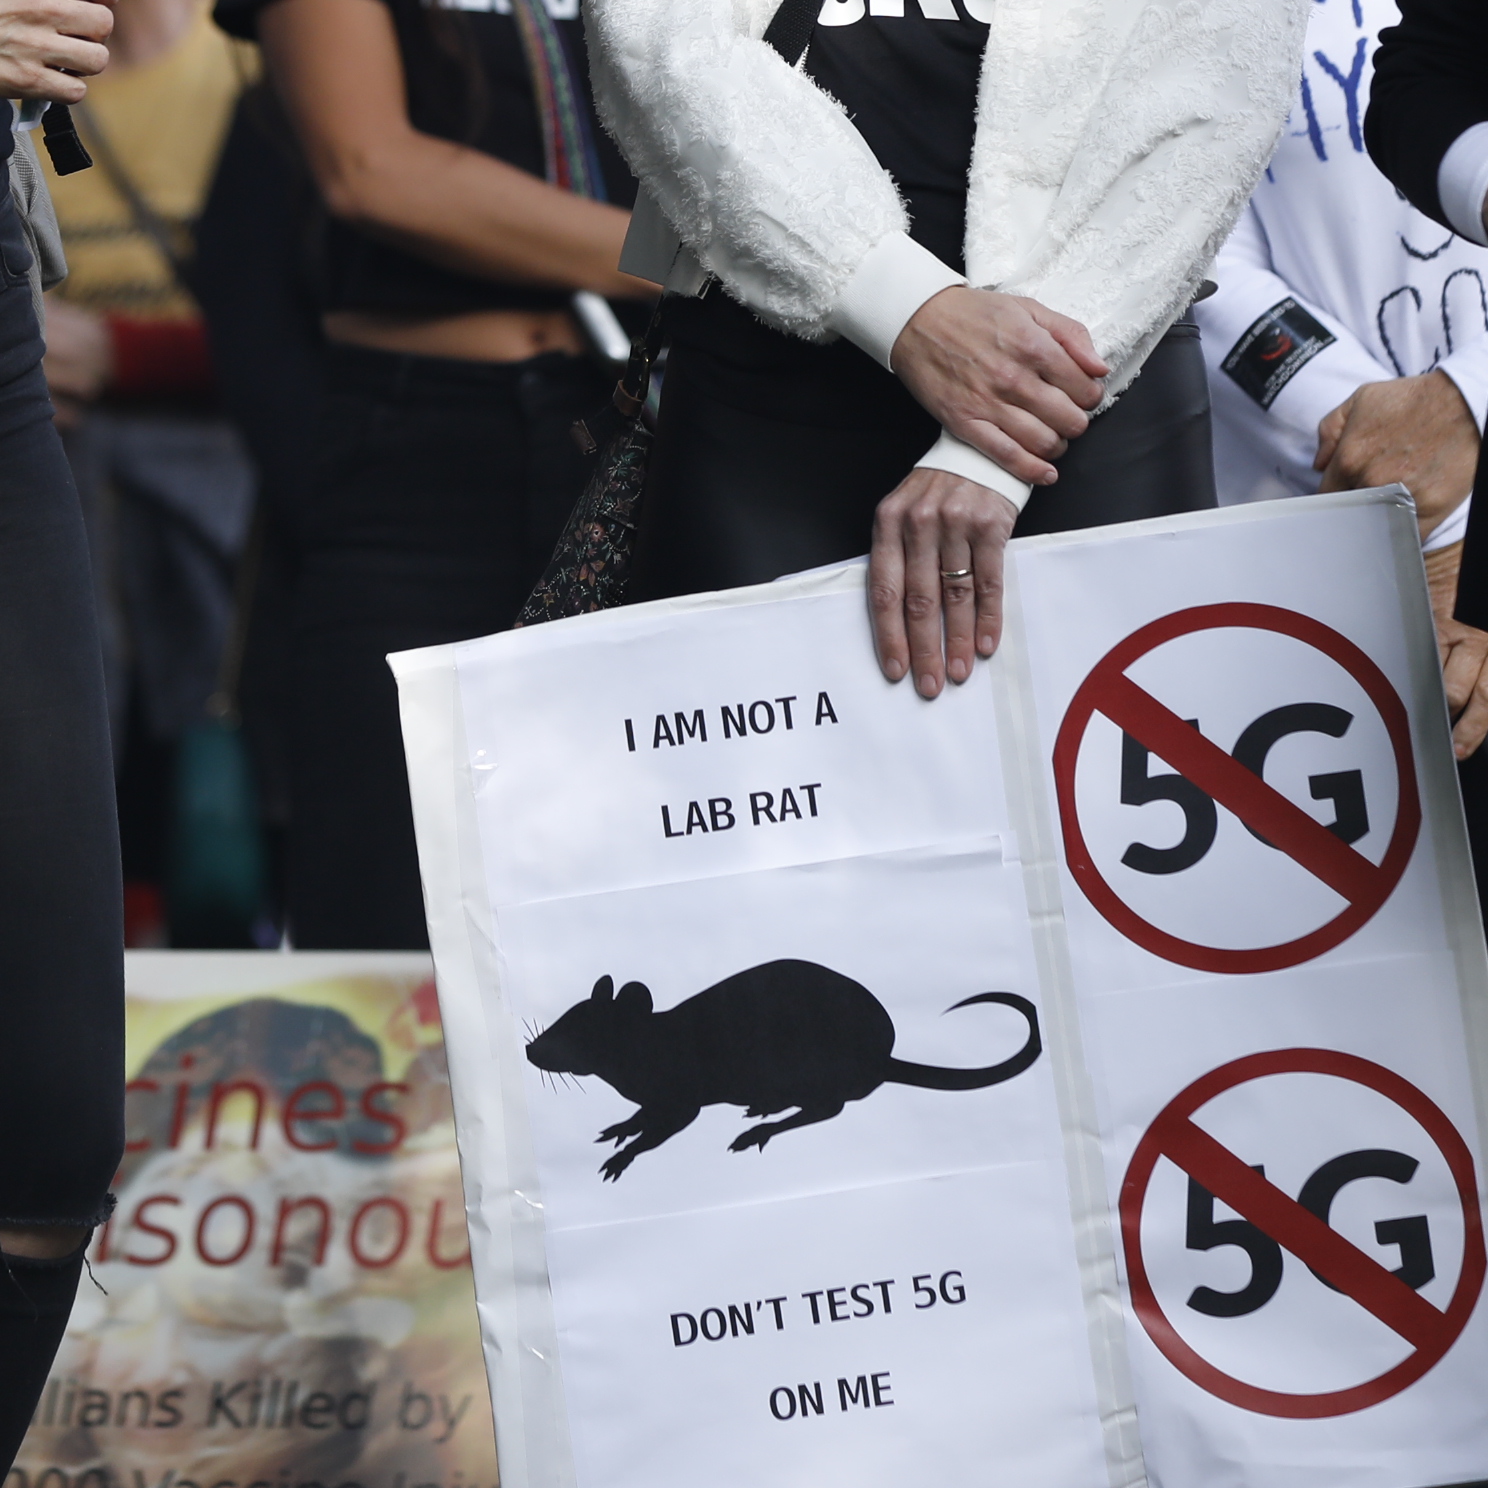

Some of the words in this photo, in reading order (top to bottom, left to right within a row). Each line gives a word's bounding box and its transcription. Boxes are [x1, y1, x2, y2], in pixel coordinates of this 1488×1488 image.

[625, 719, 635, 751] I
[653, 710, 707, 748] AM
[721, 696, 796, 738] NOT
[816, 692, 838, 725] A
[662, 798, 735, 837] LAB
[750, 784, 821, 825] RAT
[1119, 702, 1369, 876] 5G
[125, 1055, 412, 1154] cines
[94, 1176, 474, 1272] isonou
[1186, 1148, 1436, 1319] 5G
[671, 1297, 787, 1346] DON'T
[802, 1280, 894, 1324] TEST
[913, 1271, 965, 1308] 5G
[206, 1378, 374, 1430] Killed
[398, 1378, 475, 1443] by
[770, 1383, 824, 1420] ON
[838, 1373, 894, 1411] ME
